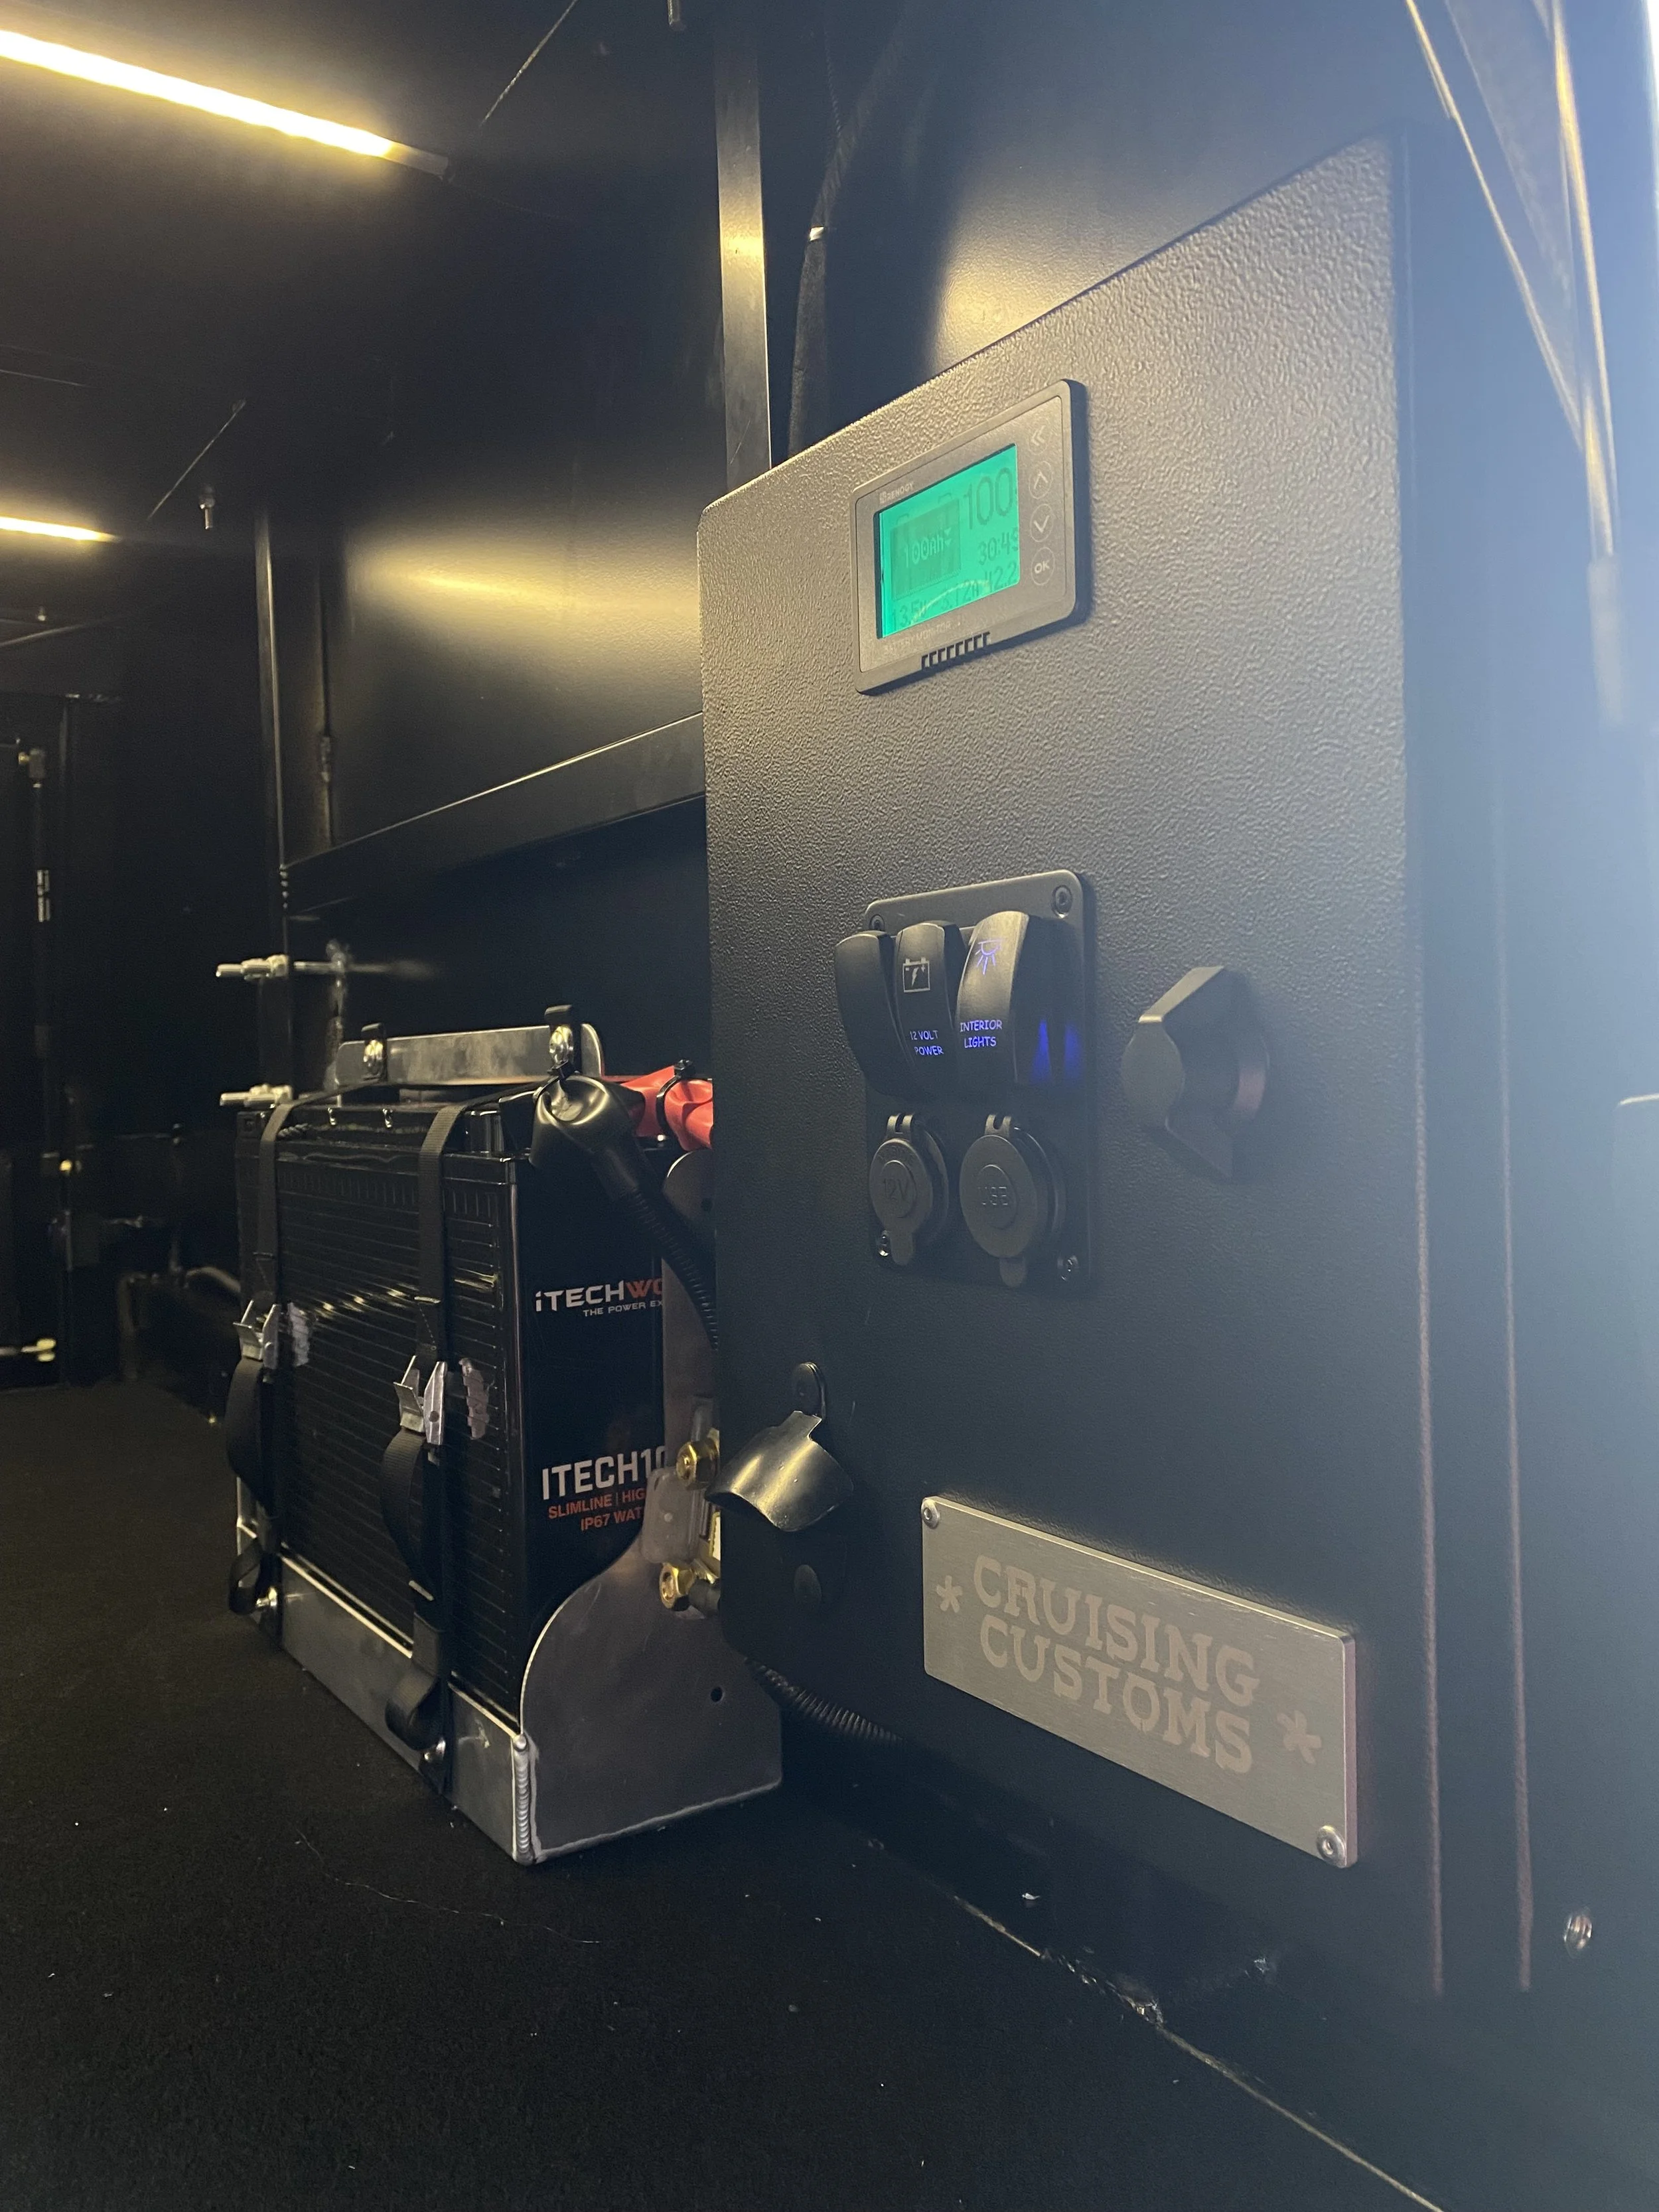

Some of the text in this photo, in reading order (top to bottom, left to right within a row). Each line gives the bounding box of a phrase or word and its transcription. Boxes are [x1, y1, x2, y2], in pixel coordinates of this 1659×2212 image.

[964, 467, 1013, 530] 100
[1035, 559, 1050, 573] OK
[909, 1029, 939, 1041] 12 VOLT
[960, 1019, 1003, 1033] INTERIOR
[914, 1045, 944, 1057] POWER
[964, 1036, 997, 1049] LIGHTS
[883, 1177, 909, 1201] 12V
[977, 1186, 1009, 1205] USB
[583, 1307, 604, 1317] THE
[608, 1301, 646, 1314] POWER
[549, 1494, 613, 1519] SLIMLINE
[581, 1513, 611, 1532] IP67
[973, 1555, 1261, 1708] CRUISING
[979, 1614, 1254, 1775] CUSTOMS
